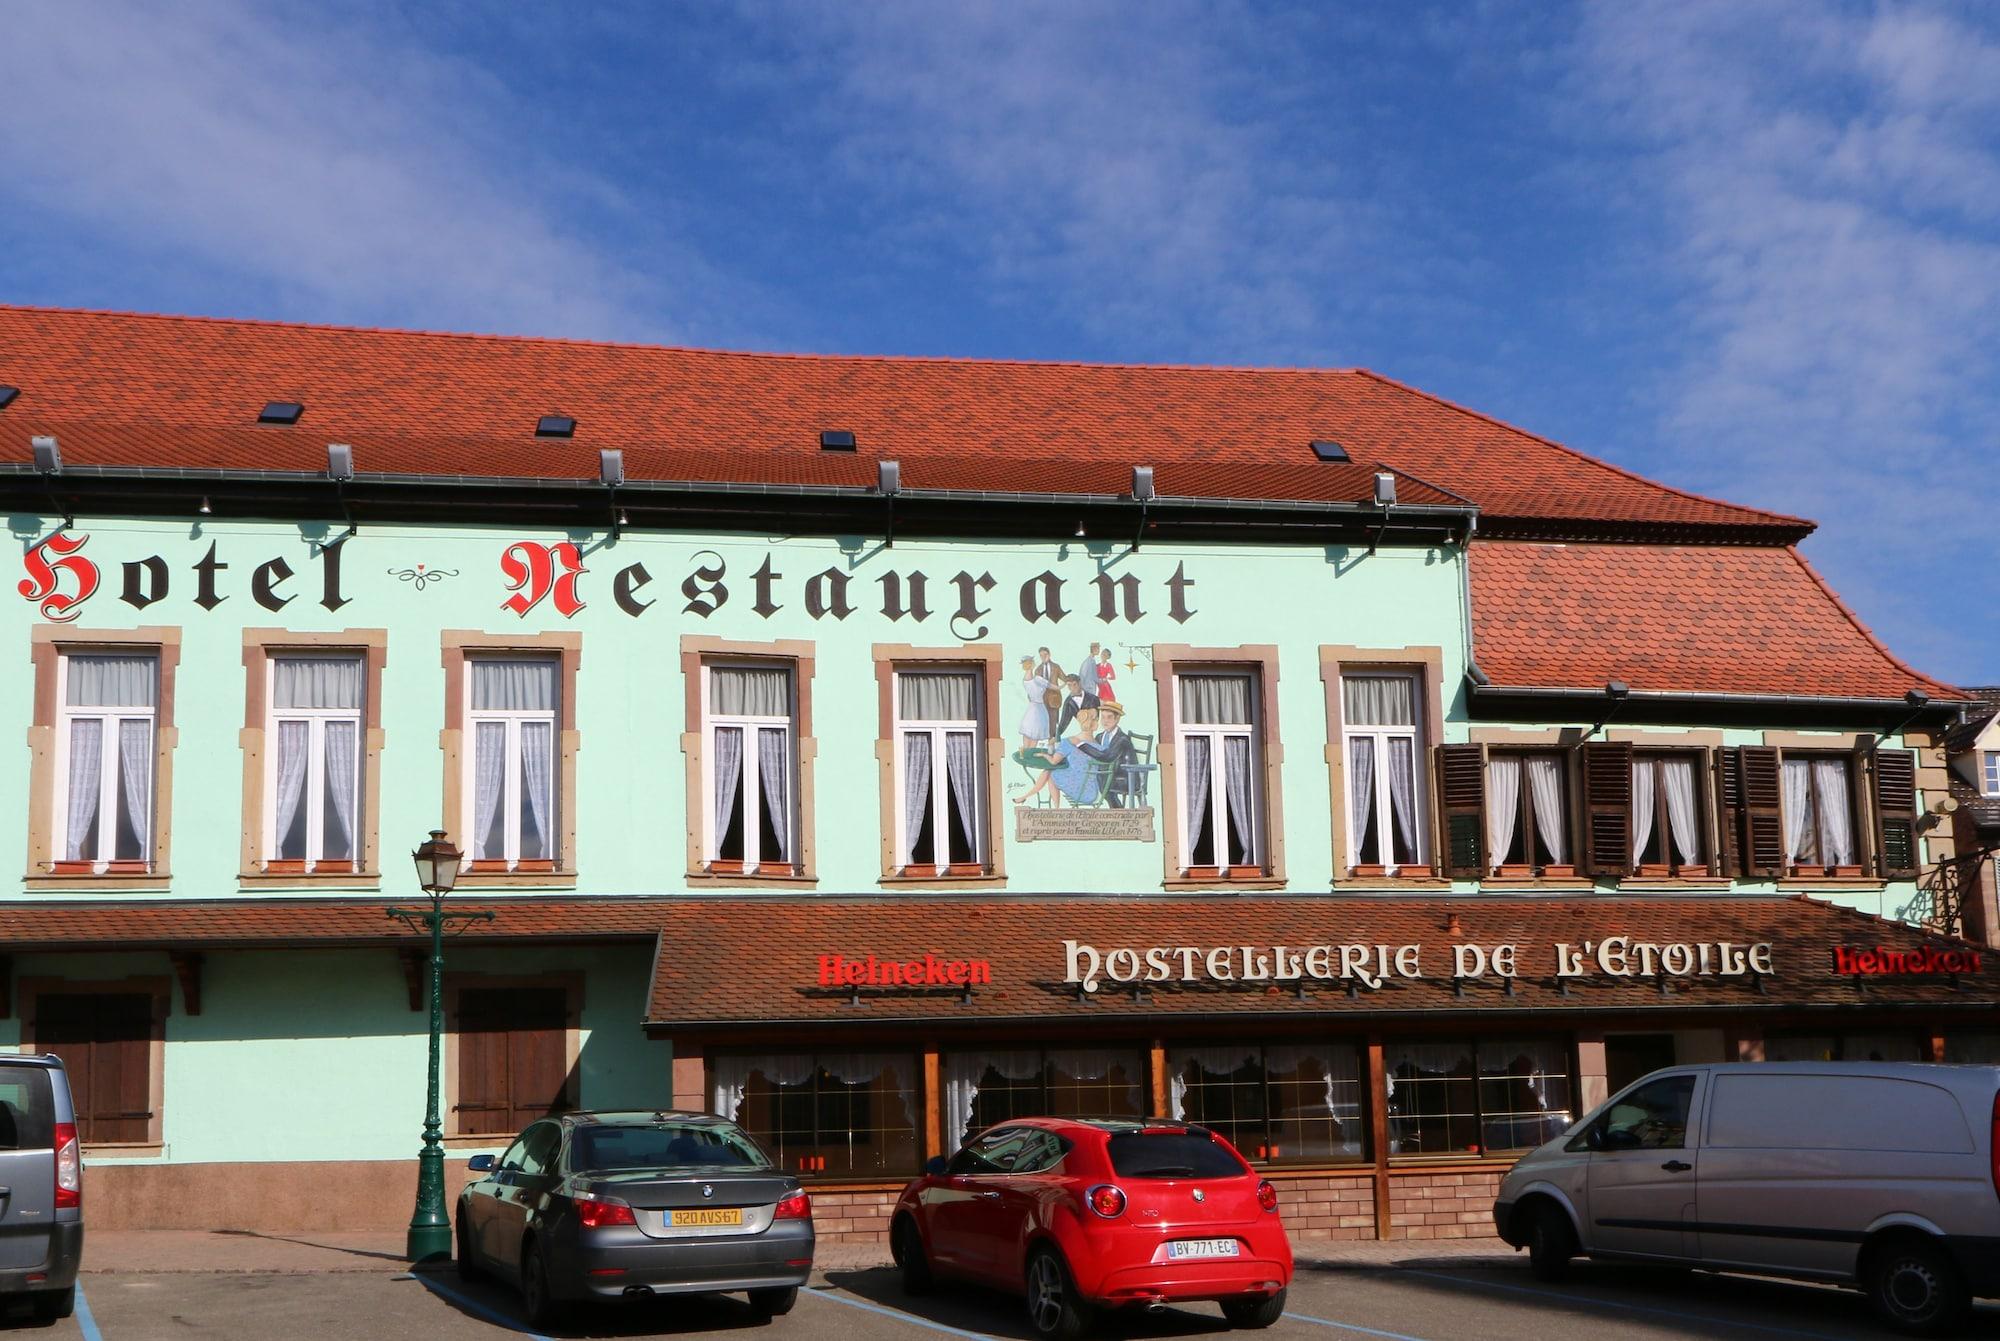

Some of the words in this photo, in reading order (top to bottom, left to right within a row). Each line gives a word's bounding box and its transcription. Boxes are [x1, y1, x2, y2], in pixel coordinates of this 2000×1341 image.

[18, 533, 354, 623] Hotel
[500, 541, 1198, 641] Restaurant
[817, 953, 991, 986] Heineken
[1062, 940, 1422, 993] HOSTELLERIE
[1452, 943, 1518, 978] DE
[1555, 936, 1775, 977] L'ETOILE
[1834, 944, 1984, 975] Heineken
